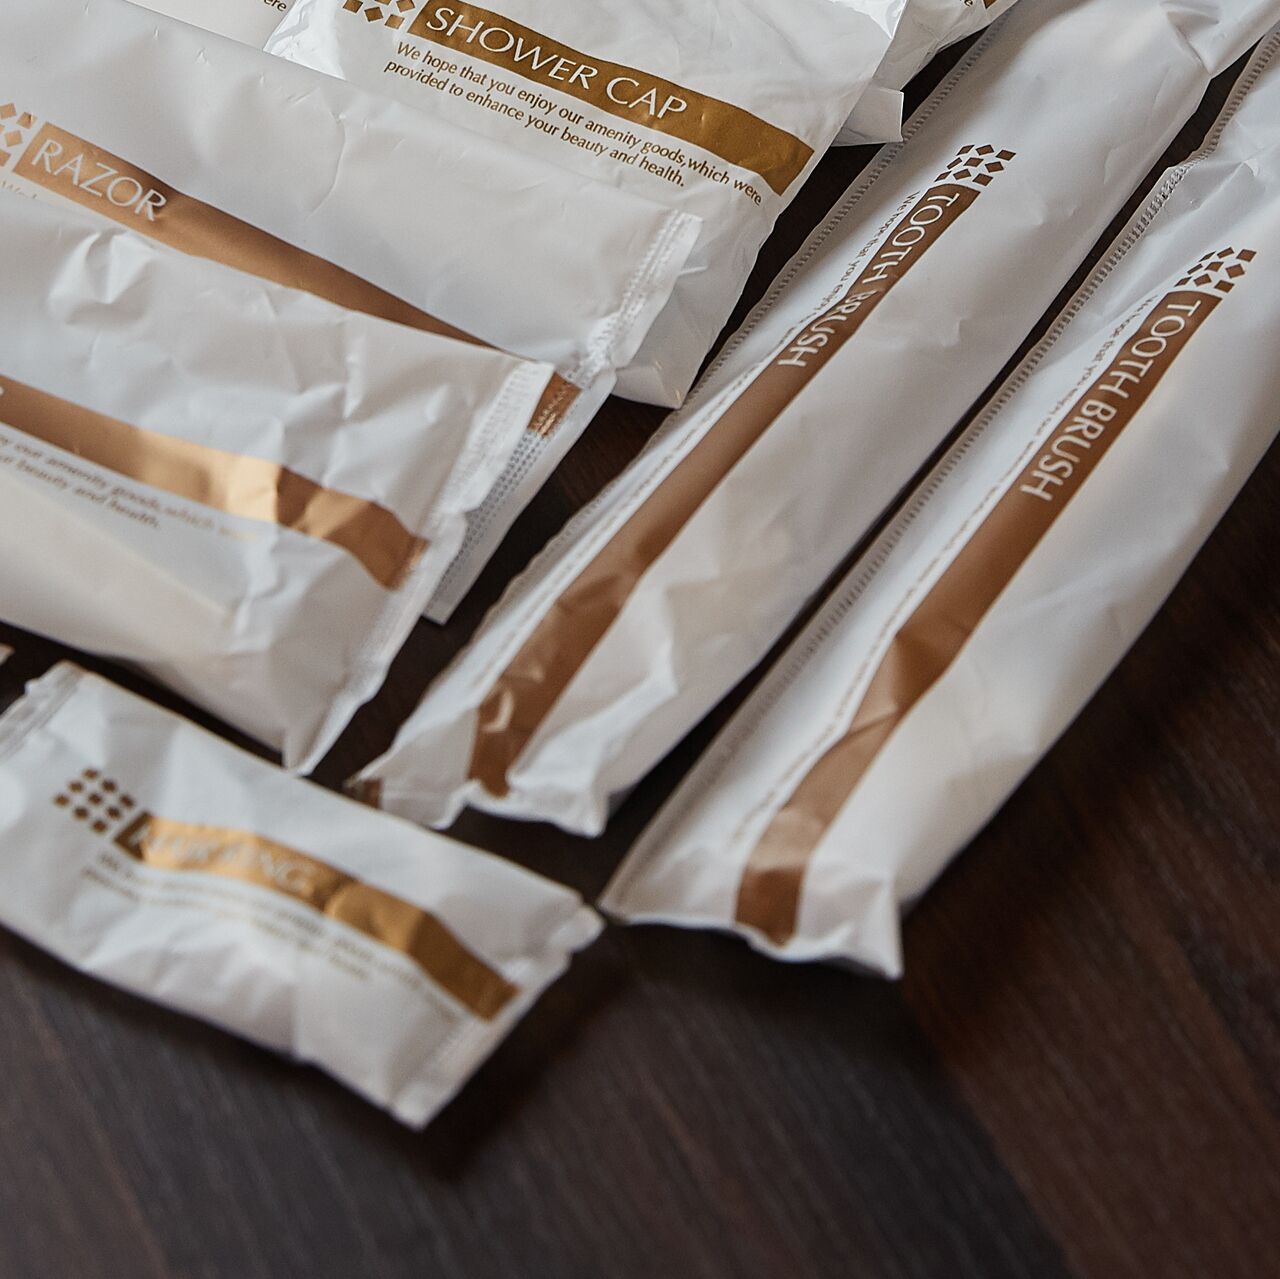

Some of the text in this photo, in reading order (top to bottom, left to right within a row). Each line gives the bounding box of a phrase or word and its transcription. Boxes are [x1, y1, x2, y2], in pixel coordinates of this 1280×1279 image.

[426, 7, 688, 119] SHOWER CAP
[30, 137, 168, 222] RAZOR
[384, 60, 685, 187] provided to enhance your beauty and health.
[397, 41, 421, 60] We
[422, 50, 458, 74] hope
[459, 66, 488, 86] that
[487, 78, 516, 96] you
[517, 89, 558, 116] enjoy
[558, 106, 585, 126] our
[584, 118, 642, 150] amenity
[733, 178, 763, 207] were
[777, 192, 960, 368] TOOTH BRUSH
[1098, 299, 1202, 399] TOOTH
[1020, 398, 1117, 502] BRUSH
